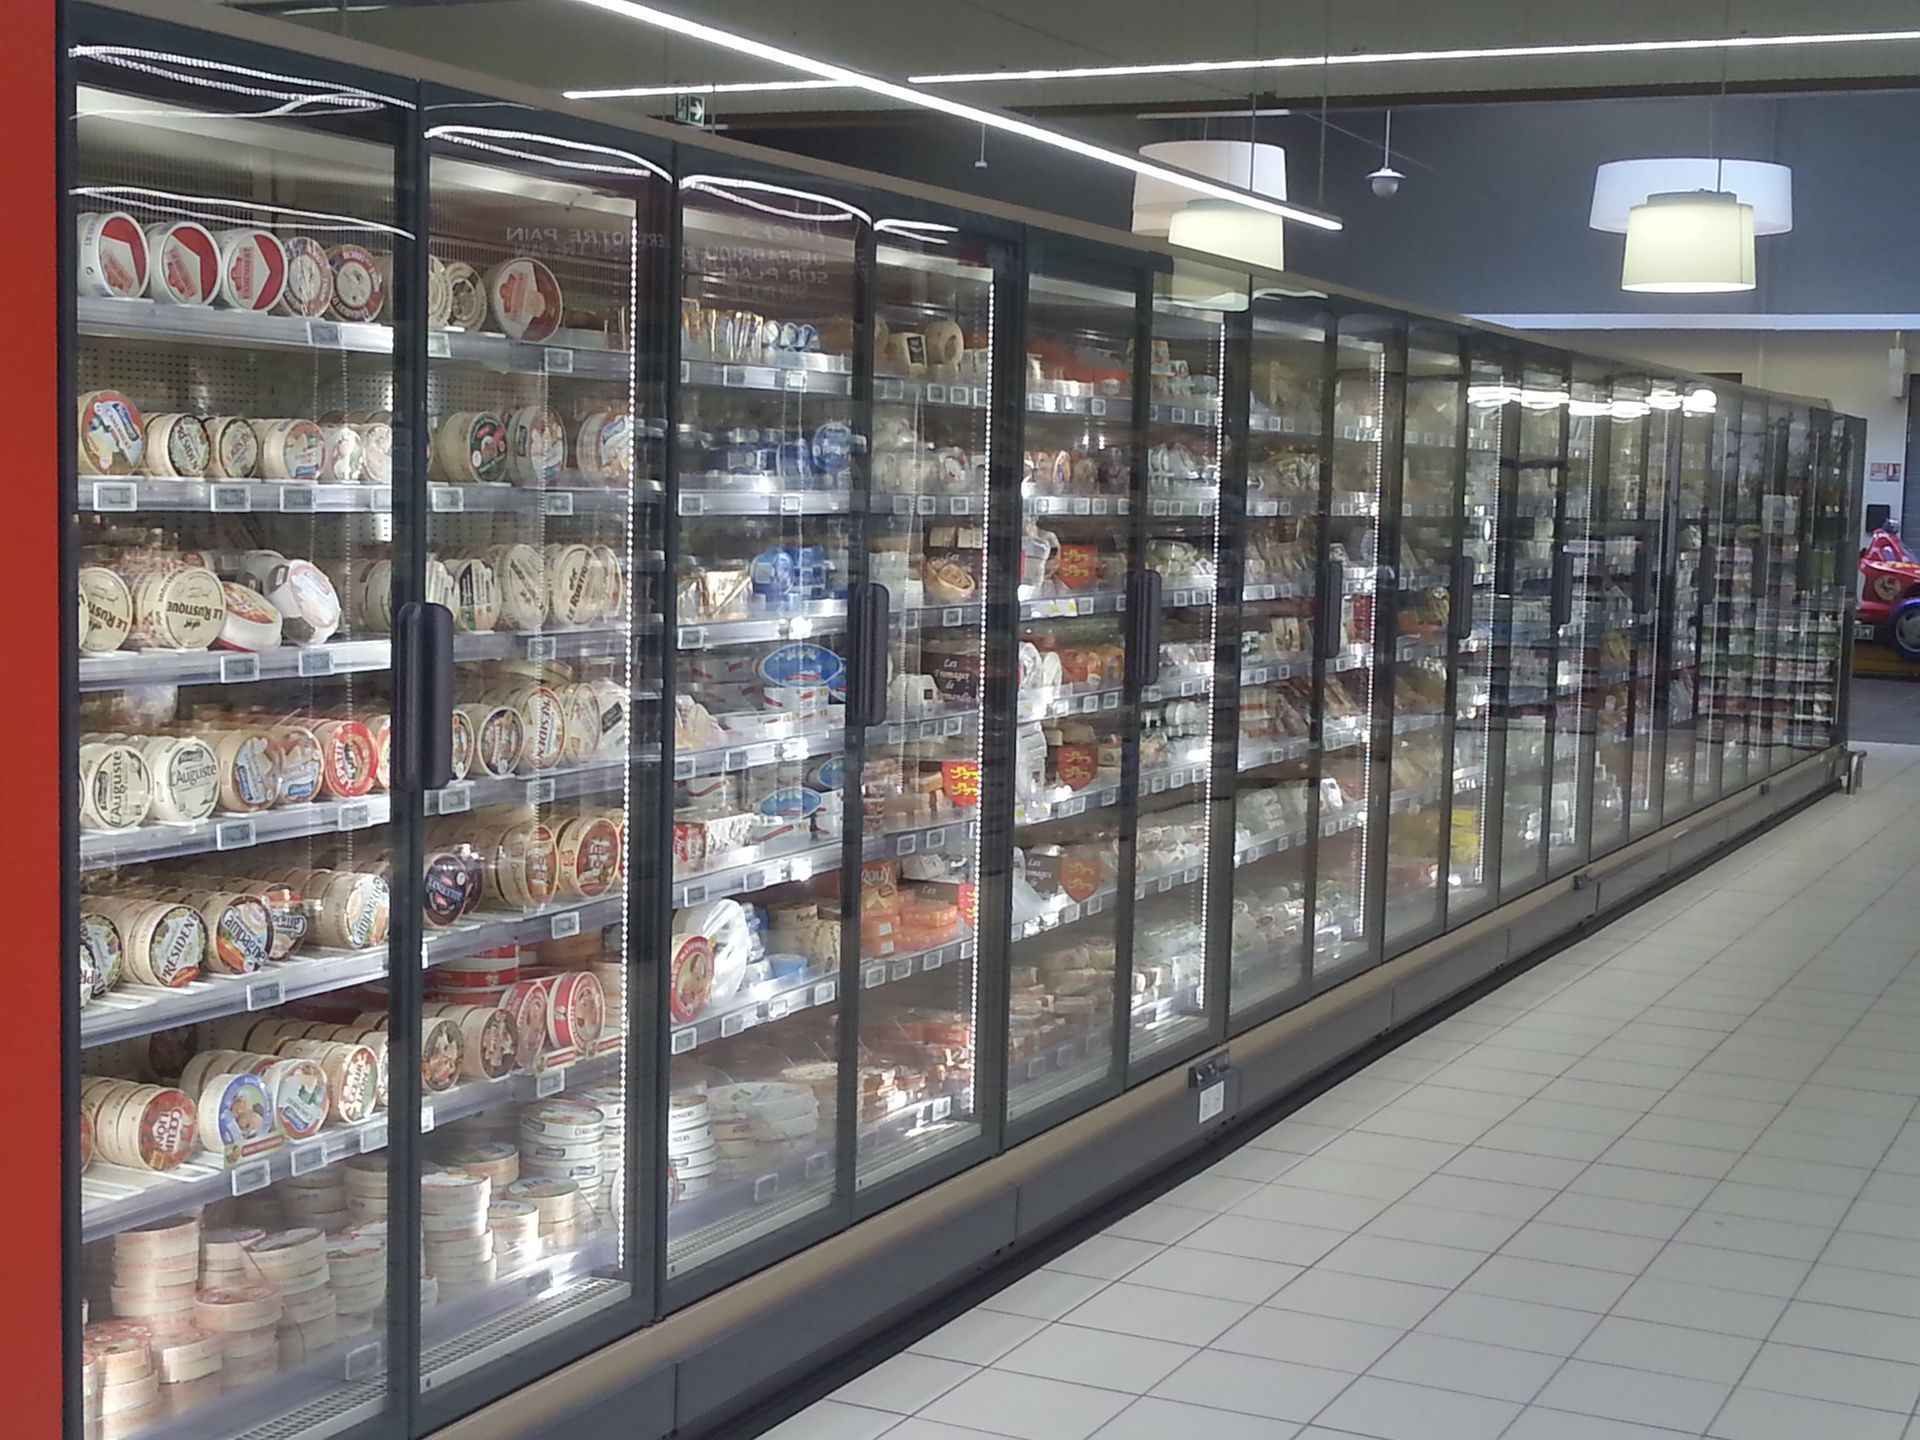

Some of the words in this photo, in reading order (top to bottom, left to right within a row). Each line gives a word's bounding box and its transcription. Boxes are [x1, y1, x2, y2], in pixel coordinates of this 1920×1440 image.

[166, 601, 211, 621] RUSTIQUE
[170, 764, 217, 787] L'Auguste
[111, 750, 128, 825] L'Auguste
